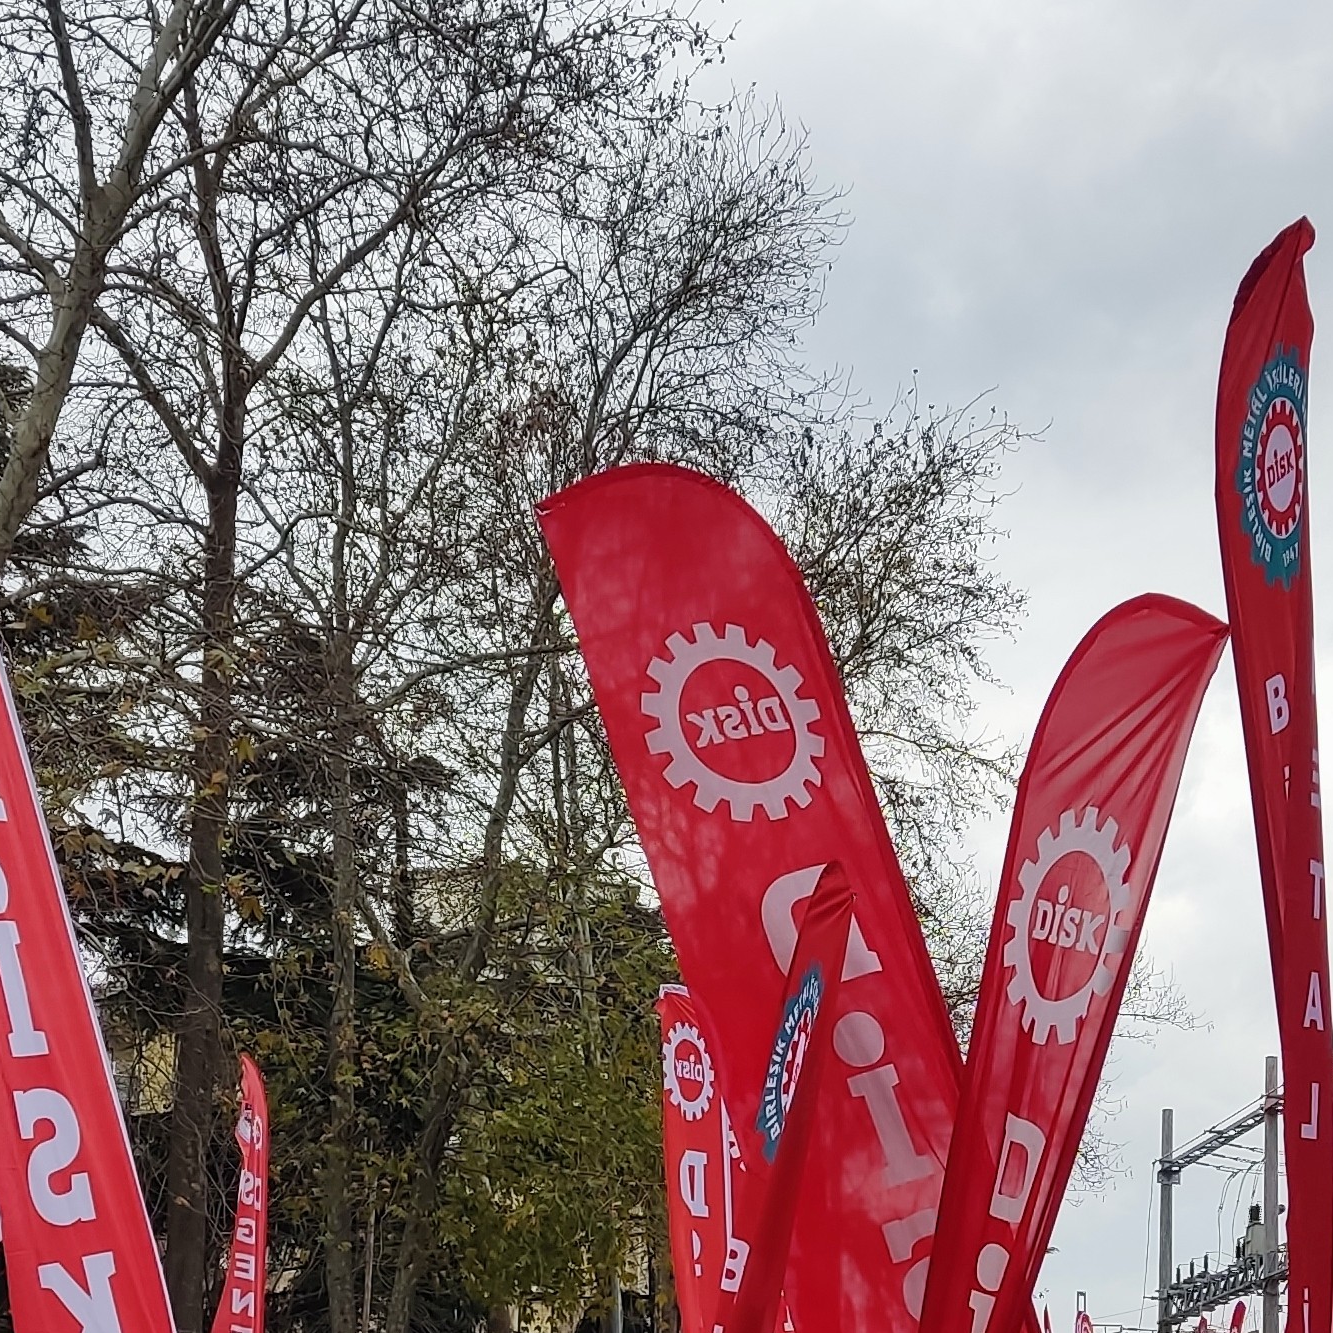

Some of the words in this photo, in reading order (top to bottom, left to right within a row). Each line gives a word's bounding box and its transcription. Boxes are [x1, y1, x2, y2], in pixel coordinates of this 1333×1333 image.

[1242, 382, 1269, 461] METAL
[1267, 448, 1295, 490] DİSK
[1032, 885, 1106, 956] DİSK
